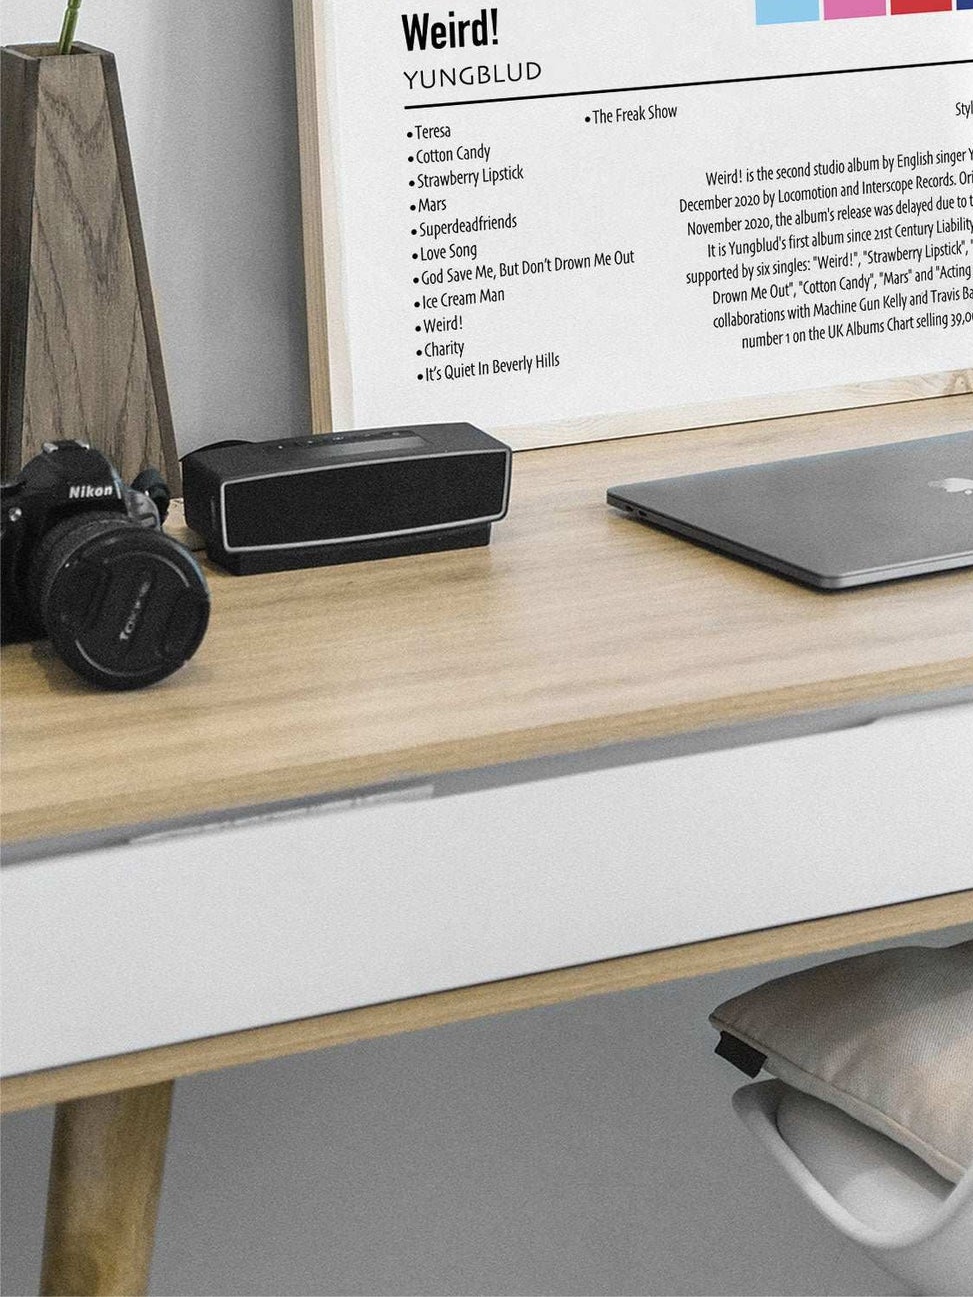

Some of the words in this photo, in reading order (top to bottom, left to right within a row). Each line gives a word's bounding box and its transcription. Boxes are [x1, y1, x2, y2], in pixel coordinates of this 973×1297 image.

[401, 7, 498, 51] Weird!
[403, 61, 542, 89] YUNGBLUD
[592, 109, 613, 124] The
[616, 105, 646, 123] Freak
[648, 104, 677, 120] Show
[414, 125, 451, 139] Teresa
[416, 149, 453, 164] Cotton
[456, 143, 490, 163] Candy
[417, 170, 479, 189] Strawberry
[482, 164, 524, 186] Lipstick
[705, 169, 742, 186] Weird!
[746, 168, 754, 182] is
[756, 166, 774, 181] the
[776, 161, 810, 179] second
[813, 159, 845, 176] studio
[847, 157, 880, 173] album
[882, 155, 894, 173] by
[897, 151, 933, 171] English
[936, 150, 966, 167] singer
[418, 198, 446, 213] Mars
[680, 194, 732, 213] December
[734, 194, 760, 207] 2020
[763, 189, 775, 208] by
[778, 185, 838, 203] Locomotion
[840, 180, 859, 197] and
[862, 179, 913, 195] Interscope
[916, 171, 956, 189] Records.
[420, 213, 517, 240] Superdeadfriends
[688, 217, 742, 236] November
[744, 217, 773, 230] 2020,
[775, 211, 792, 227] the
[795, 207, 835, 225] album's
[837, 205, 872, 221] release
[874, 205, 894, 217] was
[896, 196, 933, 217] delayed
[936, 195, 955, 210] due
[956, 196, 967, 208] to
[420, 247, 446, 261] Love
[449, 243, 477, 261] Song
[708, 244, 716, 258] It
[718, 243, 726, 257] is
[728, 235, 786, 257] Yungblud's
[788, 234, 810, 249] first
[812, 231, 844, 247] album
[846, 229, 872, 243] since
[874, 226, 892, 240] 21st
[895, 223, 934, 238] Century
[421, 268, 443, 285] God
[447, 268, 472, 283] Save
[475, 265, 496, 280] Me,
[499, 263, 520, 277] But
[522, 257, 552, 275] Don't
[554, 257, 590, 271] Drown
[594, 253, 612, 267] Me
[614, 250, 635, 265] Out
[686, 263, 739, 287] supported
[742, 263, 754, 281] by
[756, 262, 770, 277] six
[772, 257, 810, 277] singles:
[813, 251, 861, 269] "Weird!",
[863, 247, 922, 264] "Strawberry
[925, 240, 968, 261] Lipstick",
[422, 295, 438, 309] Ice
[440, 293, 476, 307] Cream
[480, 288, 504, 303] Man
[713, 291, 748, 305] Drown
[750, 286, 767, 301] Me
[770, 282, 796, 299] Out",
[799, 280, 836, 295] "Cotton
[839, 273, 877, 292] Candy",
[879, 269, 912, 285] "Mars"
[915, 266, 933, 282] and
[936, 264, 971, 281] "Acting
[713, 309, 785, 329] collaborations
[787, 303, 810, 319] with
[813, 300, 857, 317] Machine
[859, 297, 880, 311] Gun
[883, 293, 907, 311] Kelly
[909, 289, 928, 306] and
[930, 287, 960, 303] Travis
[423, 315, 462, 333] Weird!
[742, 331, 784, 349] number
[785, 333, 790, 343] 1
[792, 331, 806, 343] on
[808, 326, 826, 341] the
[828, 323, 844, 339] UK
[846, 321, 884, 337] Albums
[887, 317, 914, 331] Chart
[916, 312, 948, 329] selling
[424, 340, 464, 358] Charity
[426, 366, 442, 382] It's
[444, 363, 476, 381] Quiet
[478, 361, 489, 375] In
[492, 355, 533, 374] Beverly
[536, 352, 560, 369] Hills
[69, 485, 113, 499] Nikon
